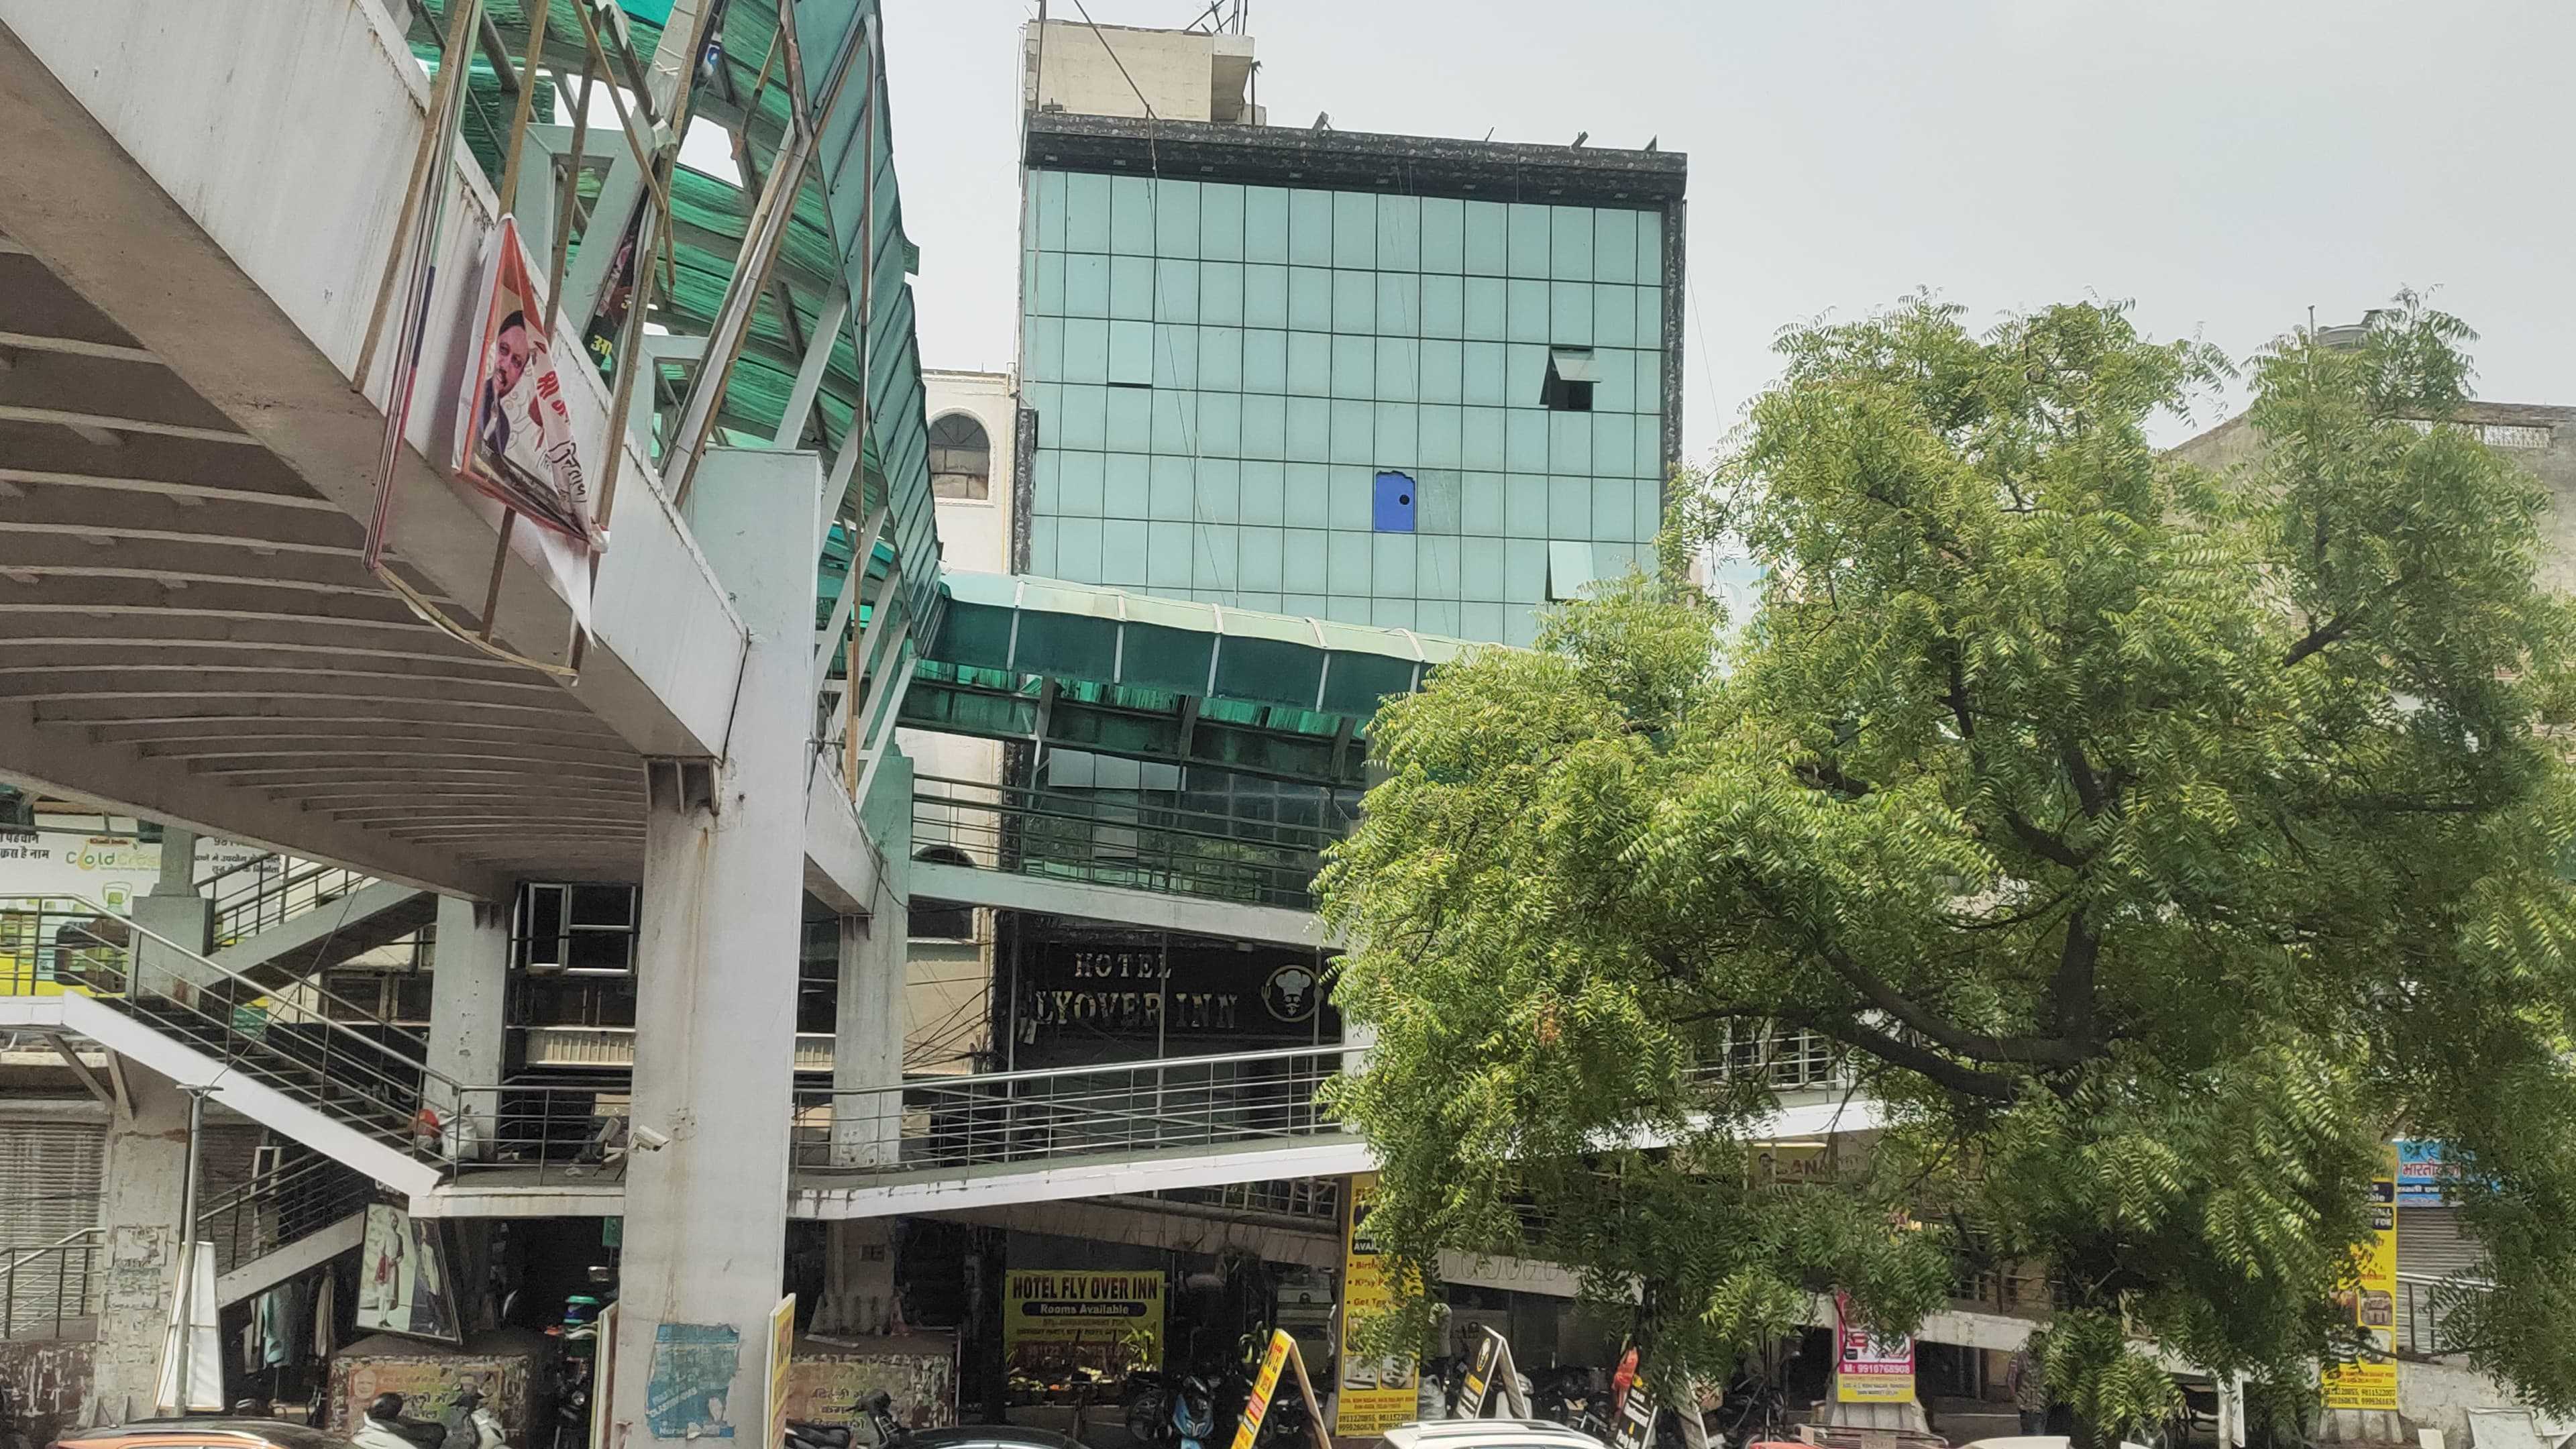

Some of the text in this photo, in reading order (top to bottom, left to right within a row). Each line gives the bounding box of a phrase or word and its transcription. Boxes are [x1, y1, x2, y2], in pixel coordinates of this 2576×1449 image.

[1075, 953, 1172, 979] HOTEL
[1176, 992, 1238, 1028] INN
[1012, 1277, 1158, 1300] HOTEL FLY OVER INN
[1040, 1303, 1129, 1316] Rooms Available
